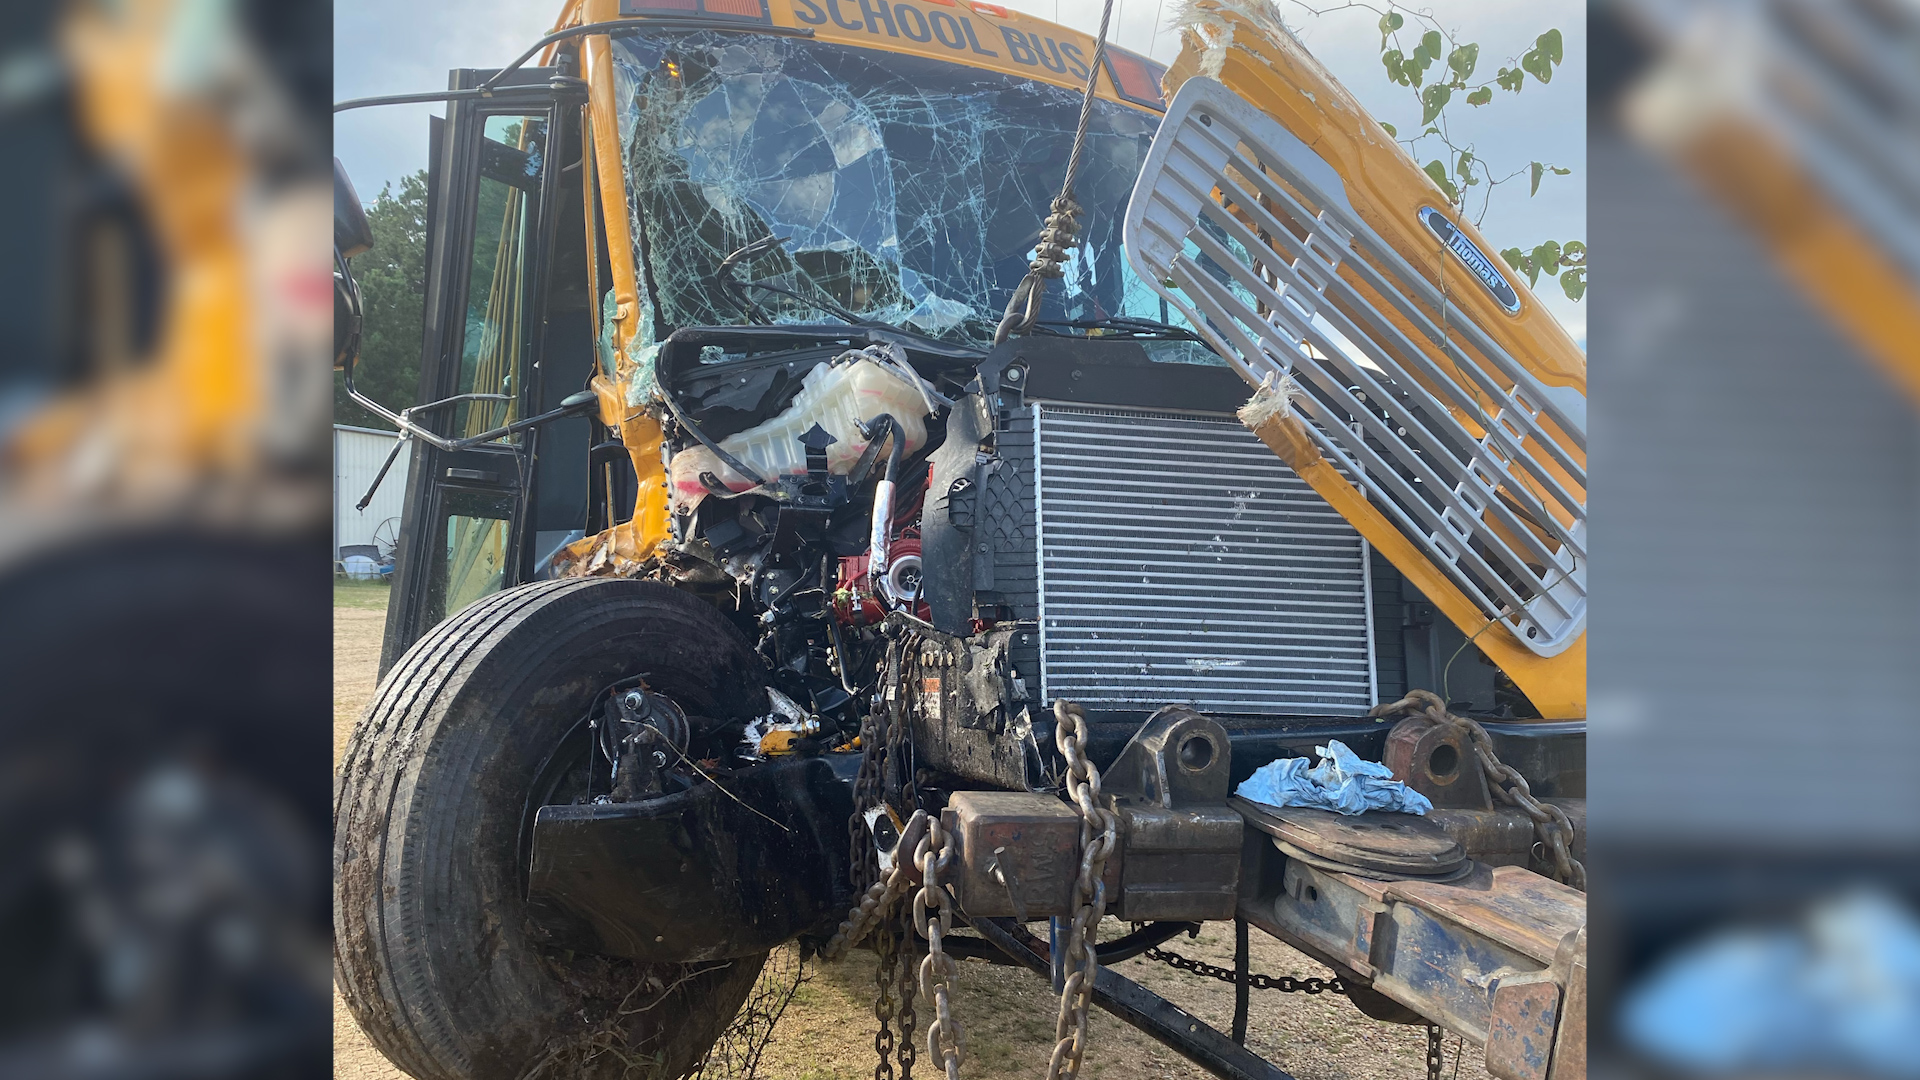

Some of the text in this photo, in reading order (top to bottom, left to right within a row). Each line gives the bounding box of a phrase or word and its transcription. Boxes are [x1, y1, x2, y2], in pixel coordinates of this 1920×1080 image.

[794, 0, 1091, 82] SCHOOL BUS
[1445, 222, 1508, 289] Thomas
